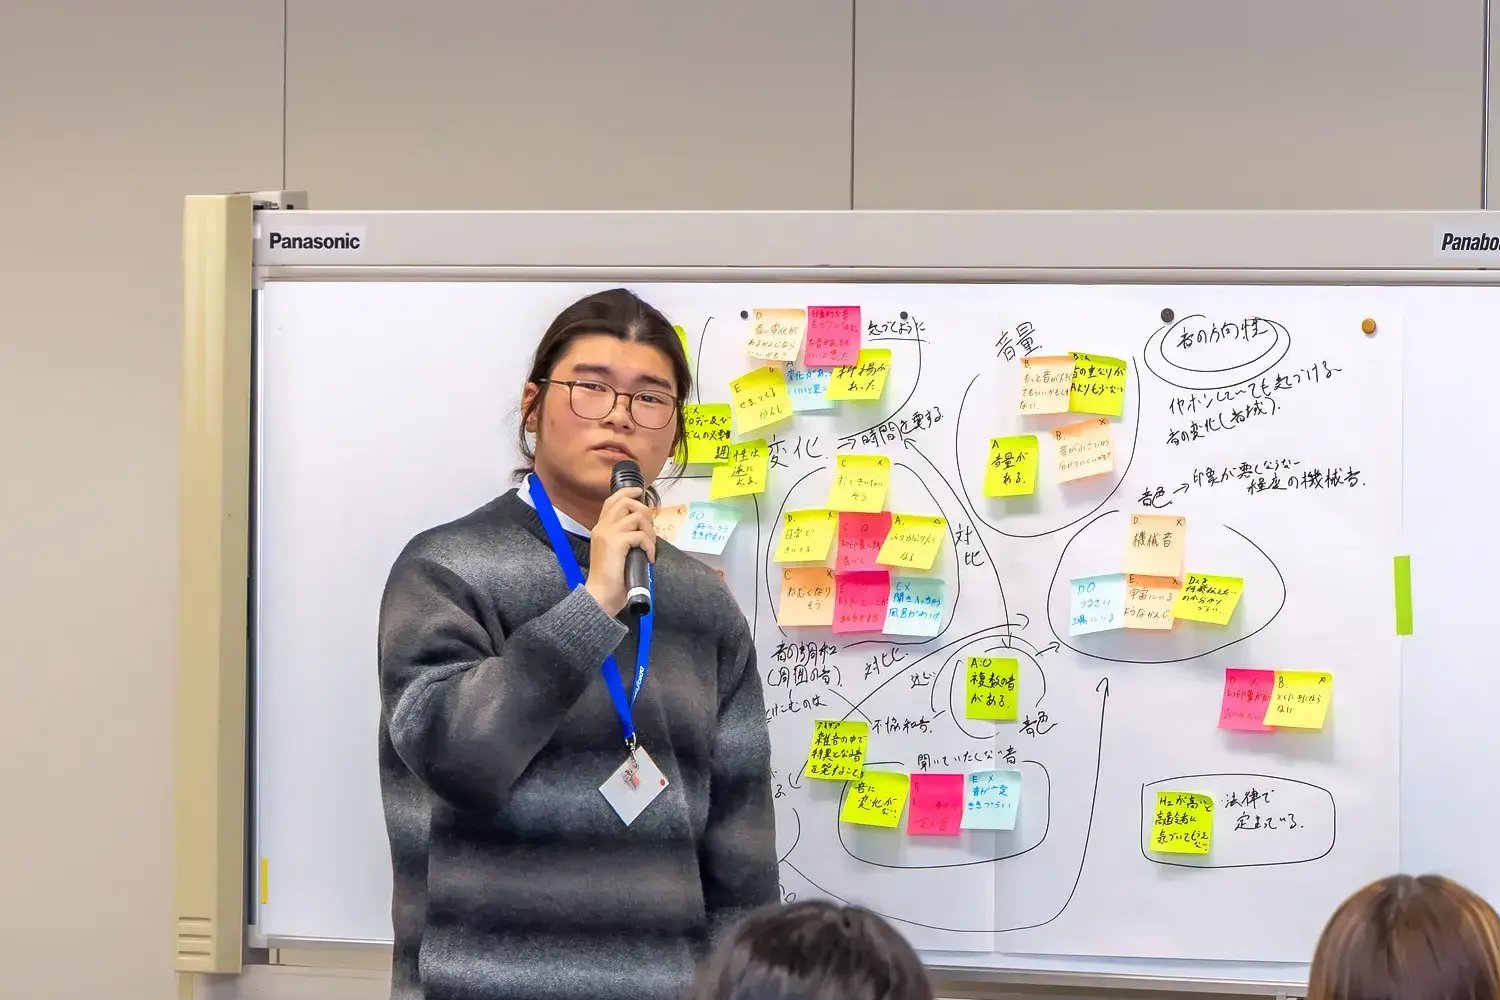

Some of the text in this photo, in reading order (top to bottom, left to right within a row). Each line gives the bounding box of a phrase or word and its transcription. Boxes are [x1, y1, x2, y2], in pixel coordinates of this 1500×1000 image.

[269, 232, 360, 250] Panasonic
[1176, 316, 1269, 349] 音の方向性
[1132, 532, 1173, 548] 機械音
[970, 672, 1016, 691] 複数の音
